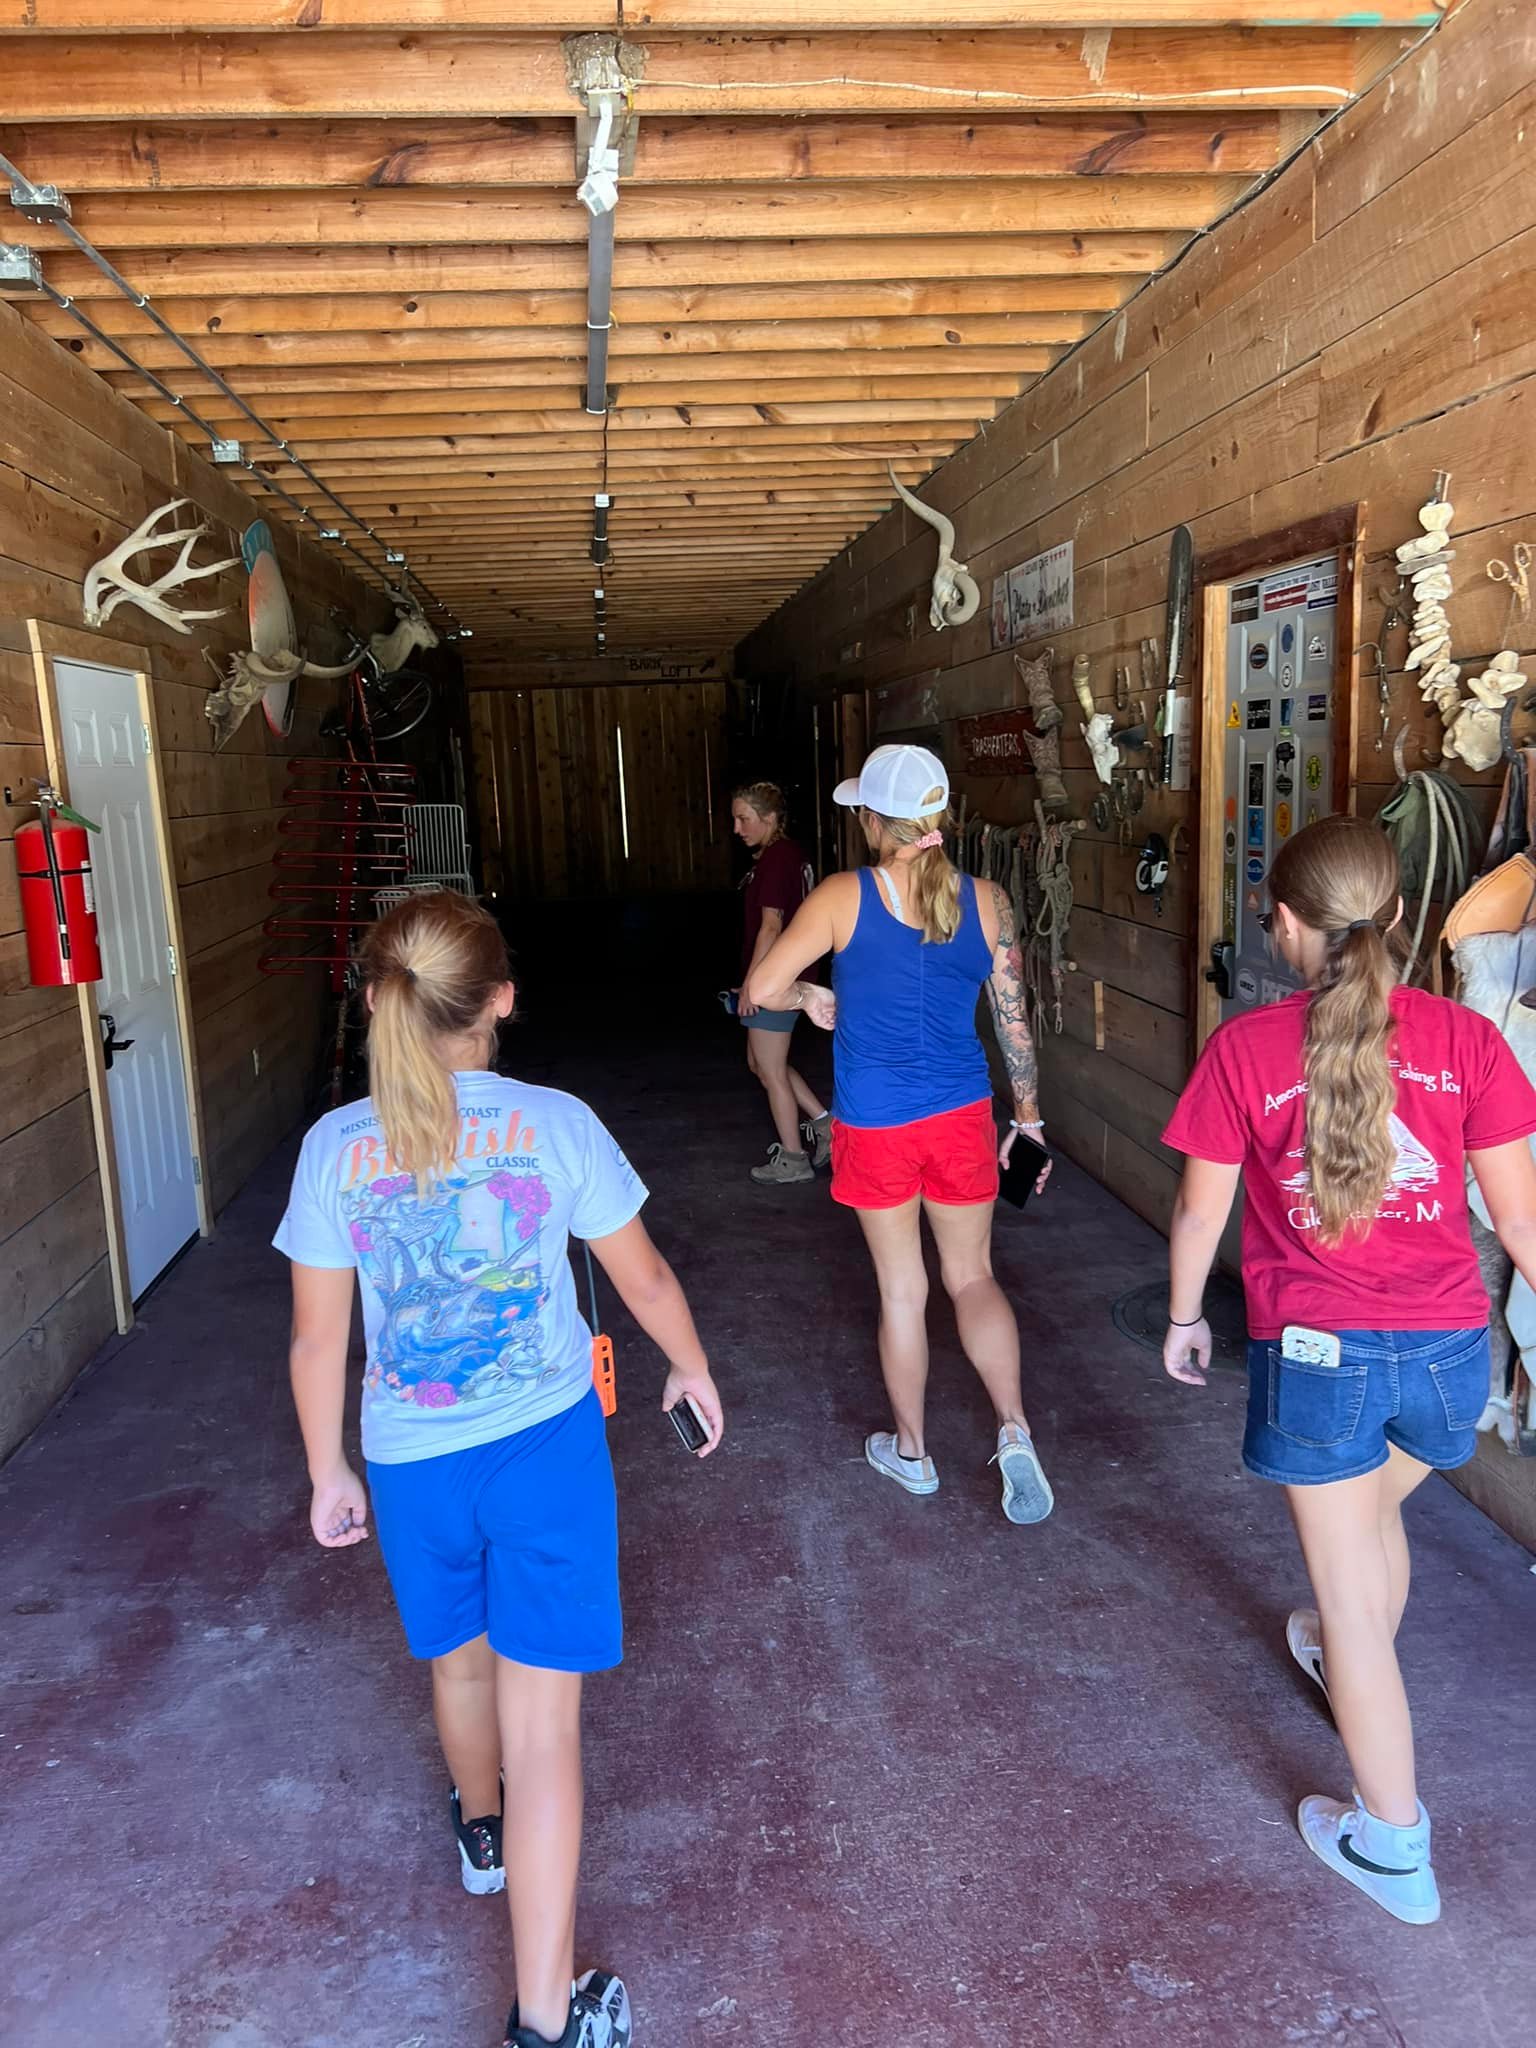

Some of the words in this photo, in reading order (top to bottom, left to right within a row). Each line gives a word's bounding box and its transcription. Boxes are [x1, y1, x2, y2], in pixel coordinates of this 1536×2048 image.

[661, 664, 695, 677] LOFT
[1264, 1080, 1309, 1116] Americ
[340, 1115, 381, 1136] MISSIS
[460, 1107, 501, 1119] COAST
[486, 1157, 540, 1169] CLASSIC
